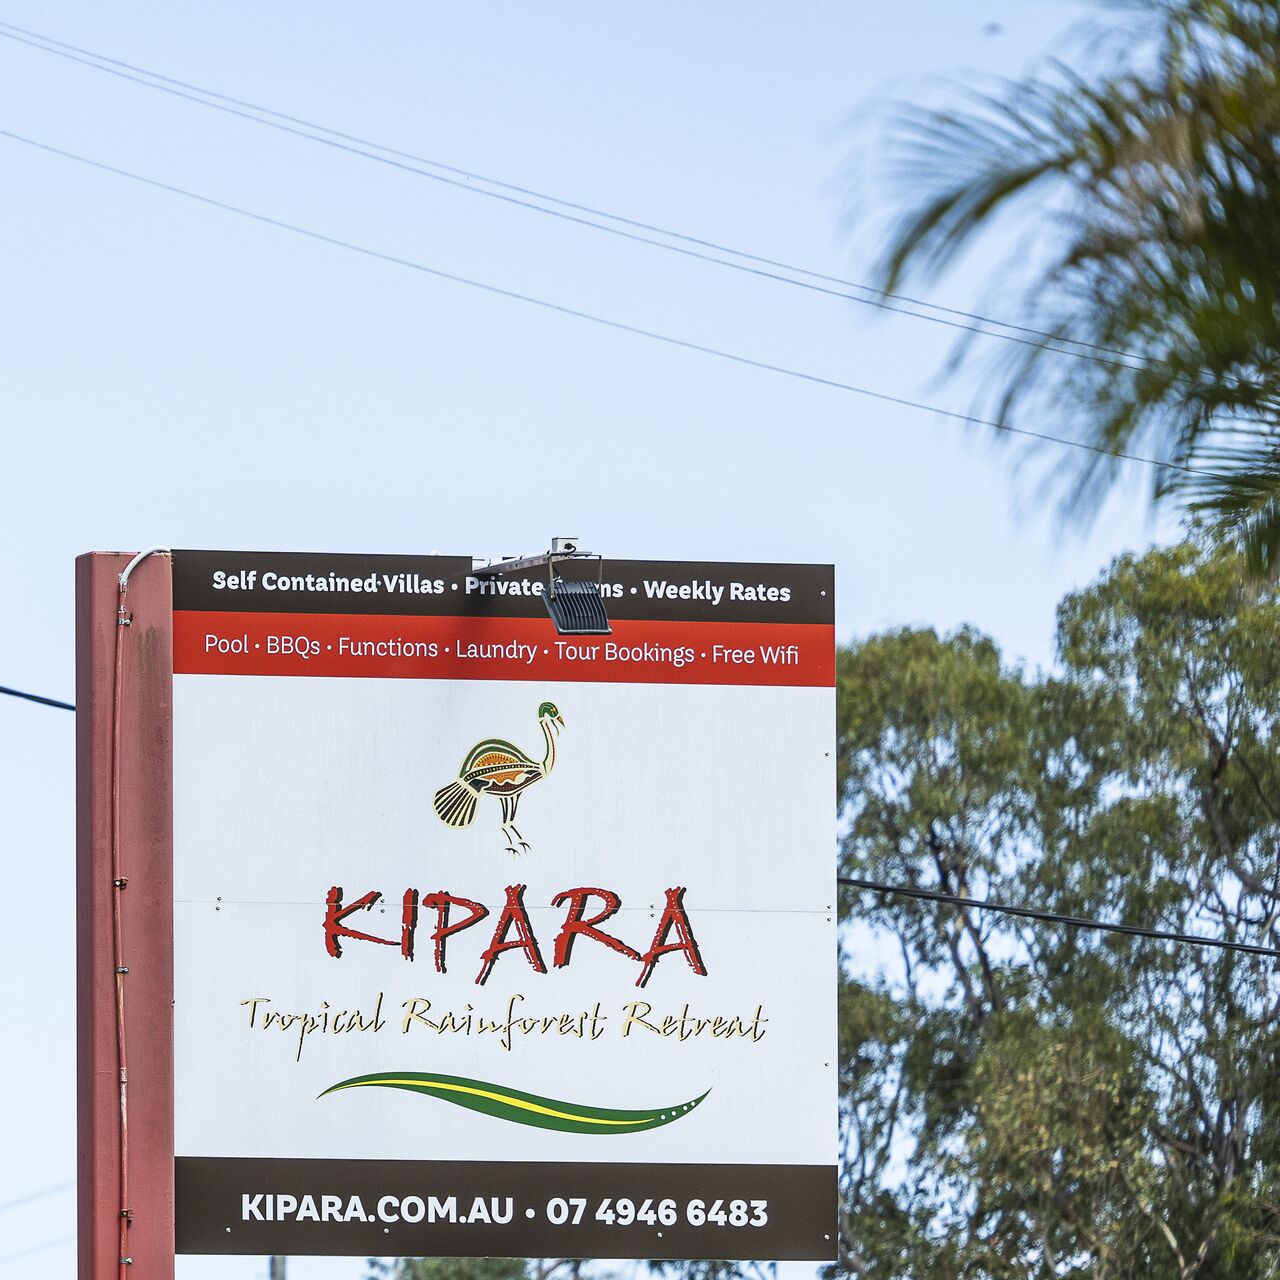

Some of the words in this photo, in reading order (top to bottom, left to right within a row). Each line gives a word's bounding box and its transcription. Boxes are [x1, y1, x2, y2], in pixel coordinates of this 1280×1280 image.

[212, 570, 257, 590] Self
[262, 572, 378, 593] Contained
[383, 574, 445, 594] Villas
[465, 576, 544, 597] Private
[643, 580, 724, 605] Weekly
[730, 581, 791, 602] Rates
[205, 634, 249, 653] Pool
[267, 635, 321, 659] BBQs
[339, 637, 438, 657] Functions
[456, 639, 537, 664] Laundry
[554, 641, 602, 661] Tour
[605, 642, 695, 667] Bookings
[713, 645, 755, 664] Free
[760, 645, 799, 665] Wifi
[322, 884, 708, 988] KIPARA
[239, 992, 386, 1062] Tropical
[401, 993, 609, 1050] Rainforest
[622, 1000, 769, 1043] Retreat
[241, 1194, 514, 1224] KIPARA.COM.AU
[546, 1198, 587, 1225] 07
[595, 1198, 677, 1226] 4946
[686, 1199, 768, 1227] 6483
